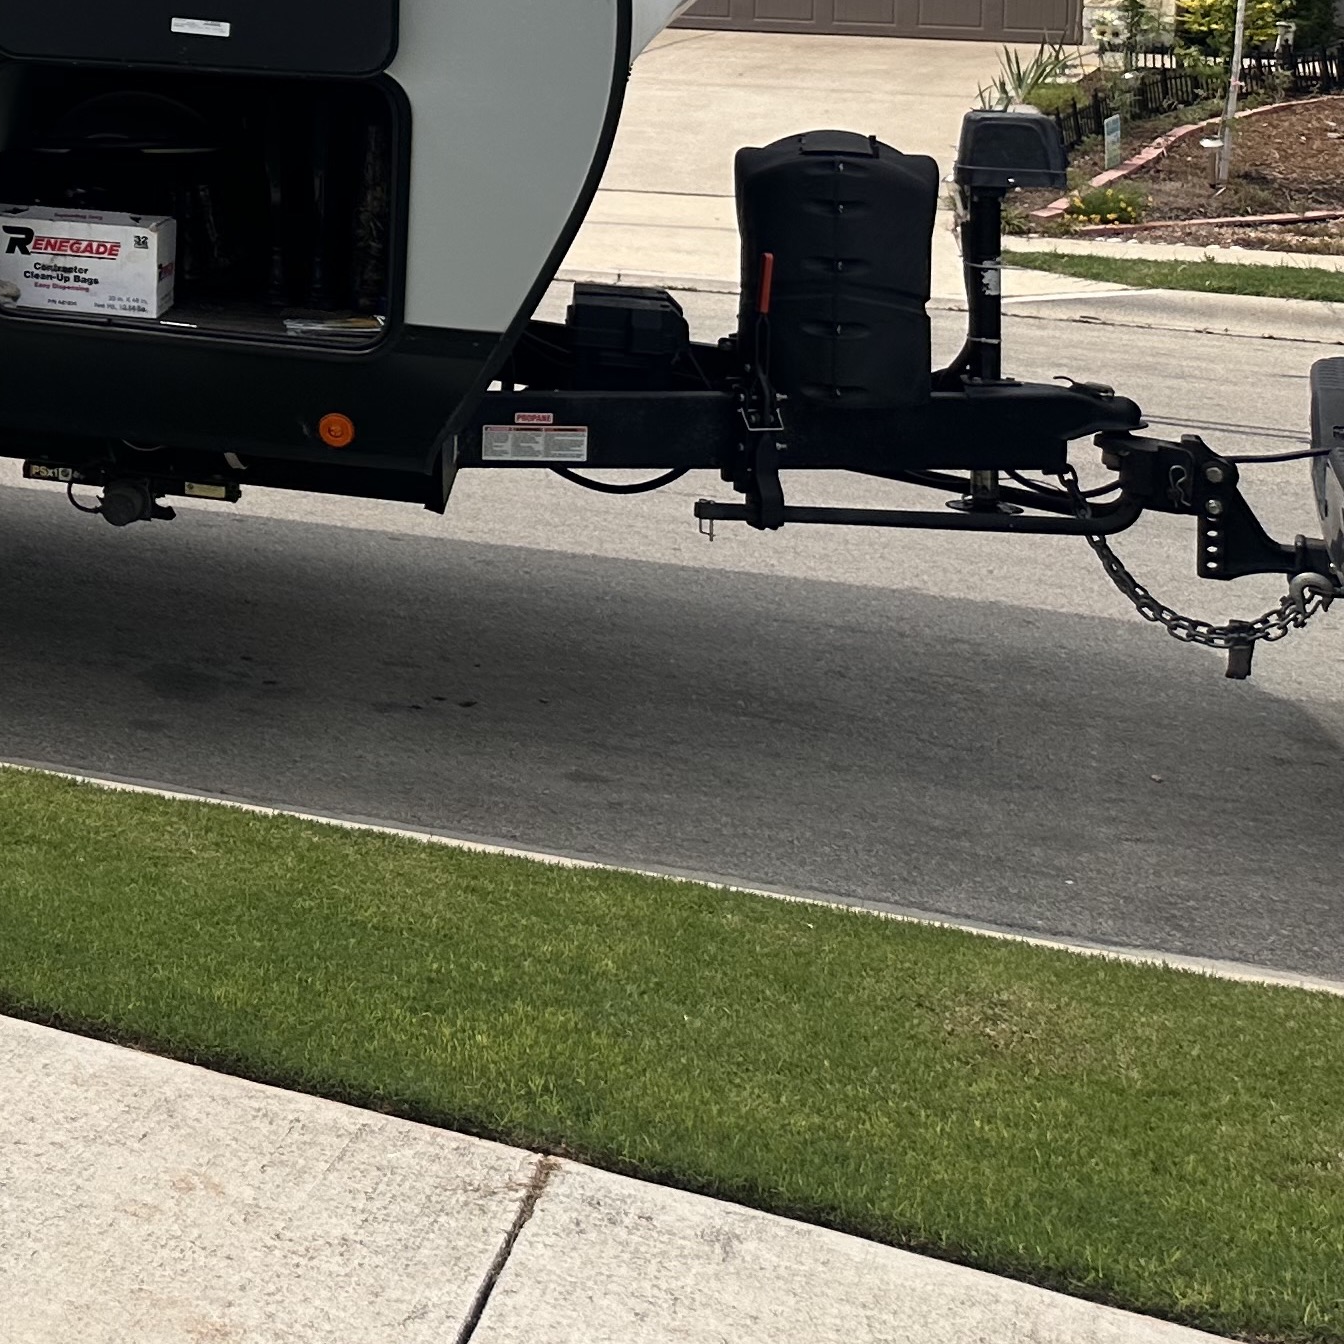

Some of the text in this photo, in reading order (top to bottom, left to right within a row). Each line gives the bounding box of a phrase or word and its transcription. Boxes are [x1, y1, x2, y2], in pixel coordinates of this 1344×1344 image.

[2, 225, 121, 257] RENEGADE
[23, 270, 99, 285] Clean-Up Bags
